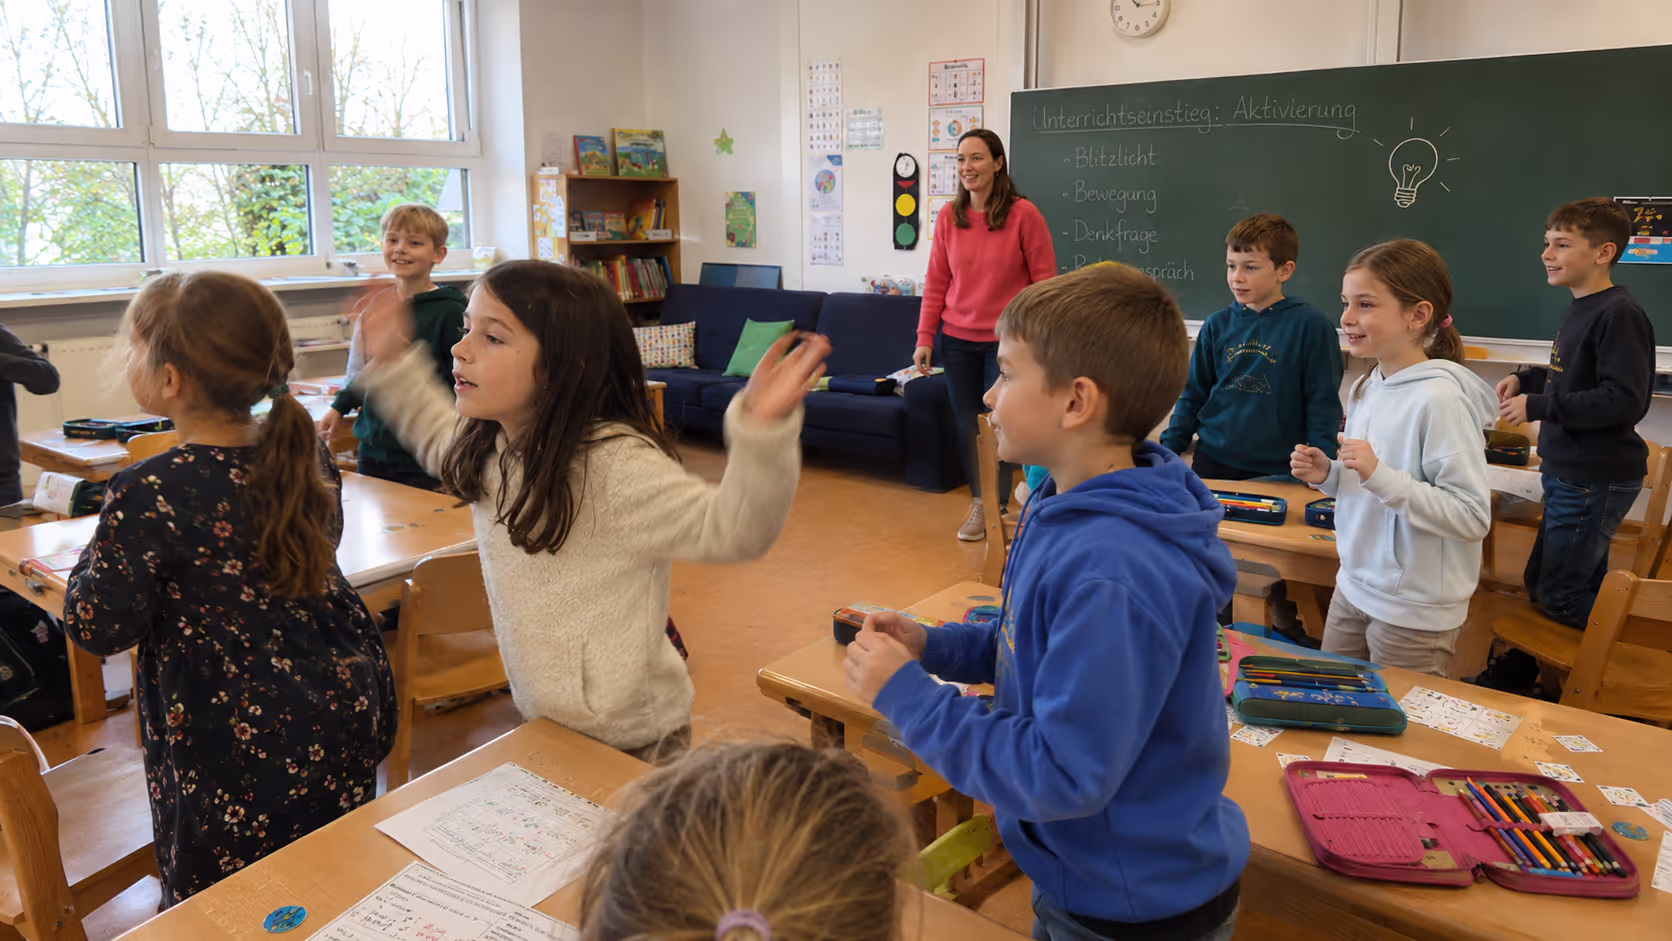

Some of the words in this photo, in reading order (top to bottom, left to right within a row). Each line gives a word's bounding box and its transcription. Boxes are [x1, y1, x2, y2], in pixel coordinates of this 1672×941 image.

[1032, 99, 1219, 135] Unterrichtseinstieg:
[1233, 95, 1356, 140] Aktivierung
[1075, 143, 1157, 168] Blitzlicht
[1075, 179, 1157, 214] Bewegung
[1074, 218, 1158, 255] Denkfrage
